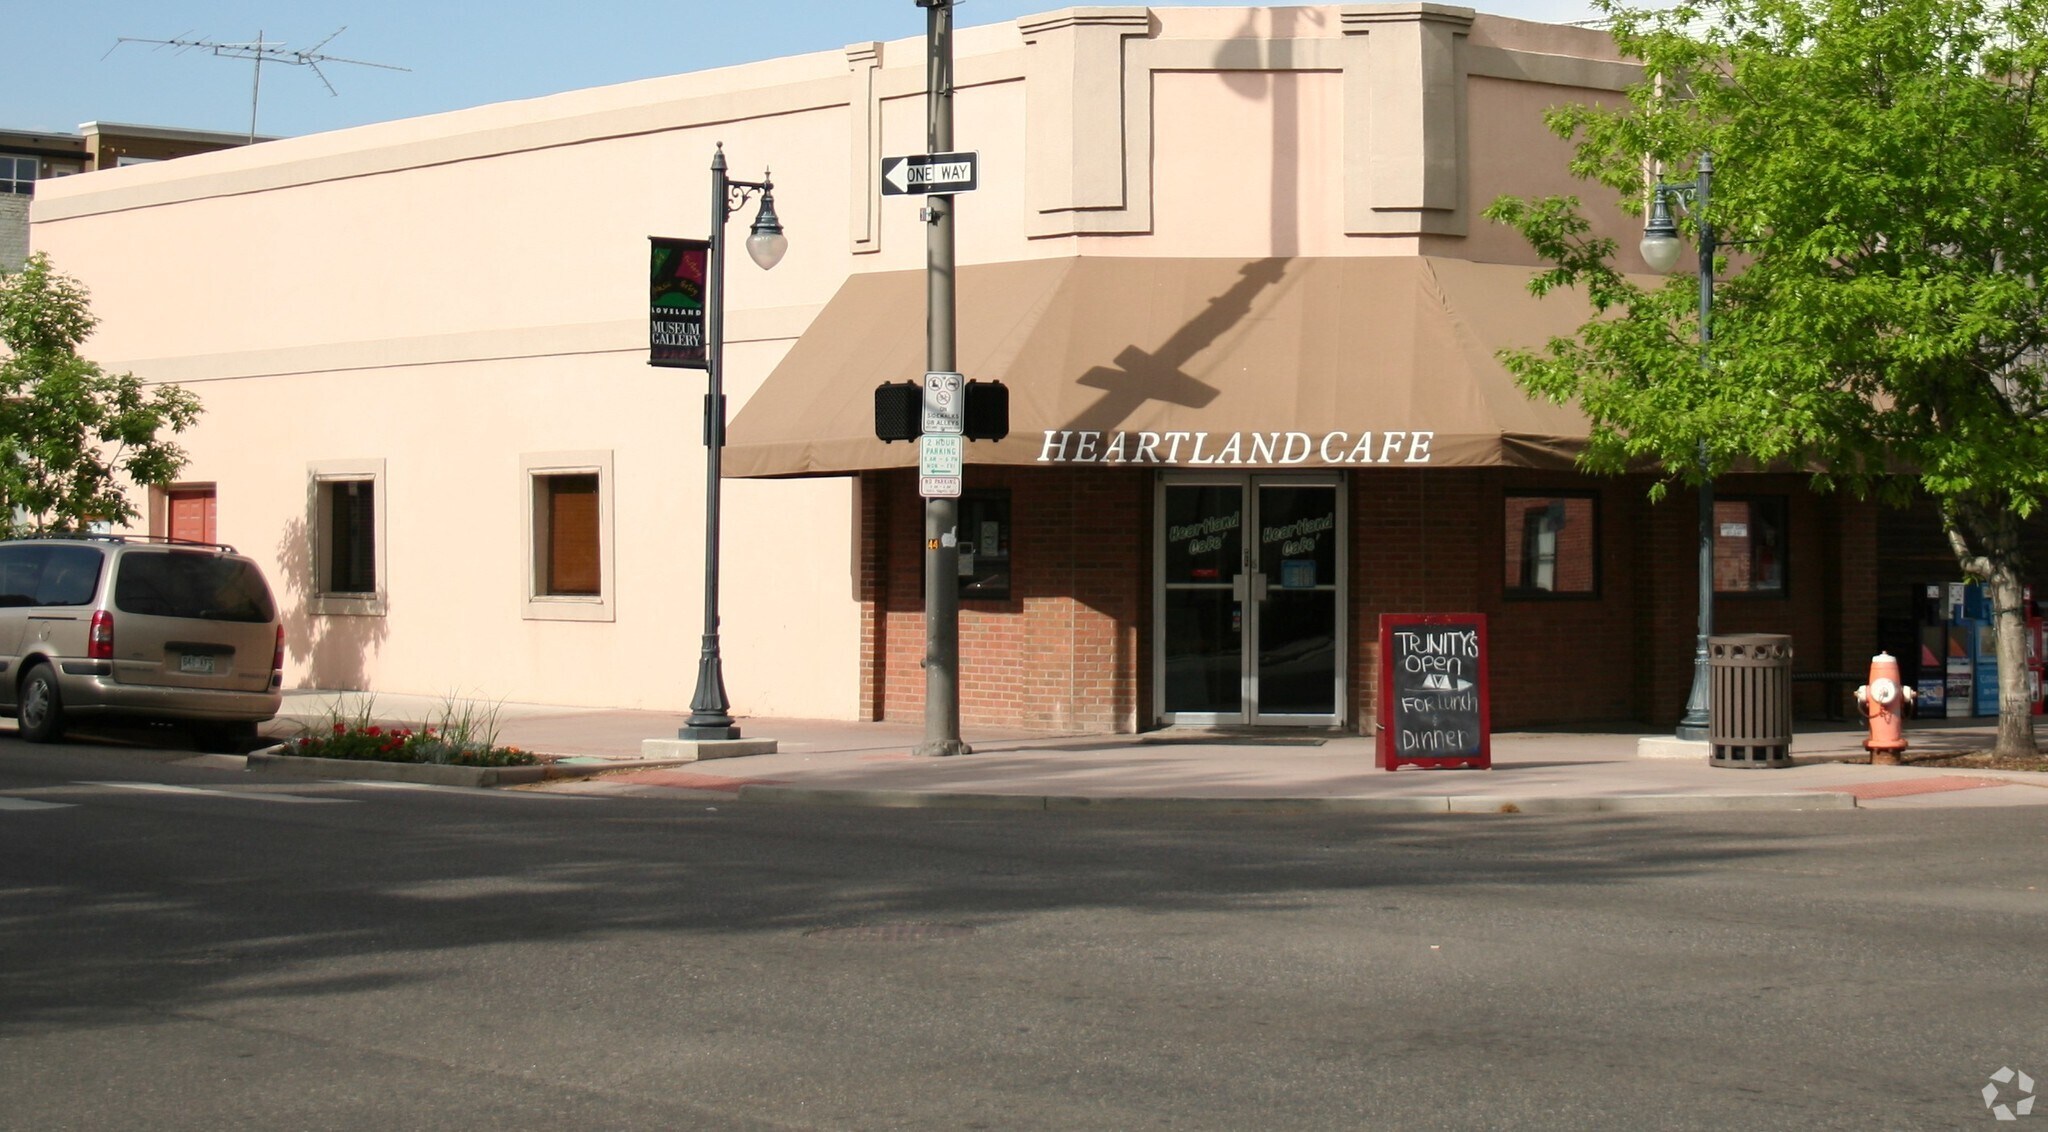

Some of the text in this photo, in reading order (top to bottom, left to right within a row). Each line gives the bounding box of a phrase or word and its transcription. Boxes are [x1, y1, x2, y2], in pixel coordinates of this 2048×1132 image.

[907, 165, 967, 182] ONE WAY
[652, 307, 701, 316] LOVELAND
[652, 321, 699, 336] MUSEUM
[652, 333, 700, 347] GALLERY
[1037, 430, 1434, 464] HEARTLAND CAFE
[1169, 511, 1239, 542] Heartland
[1263, 512, 1333, 543] Heartland
